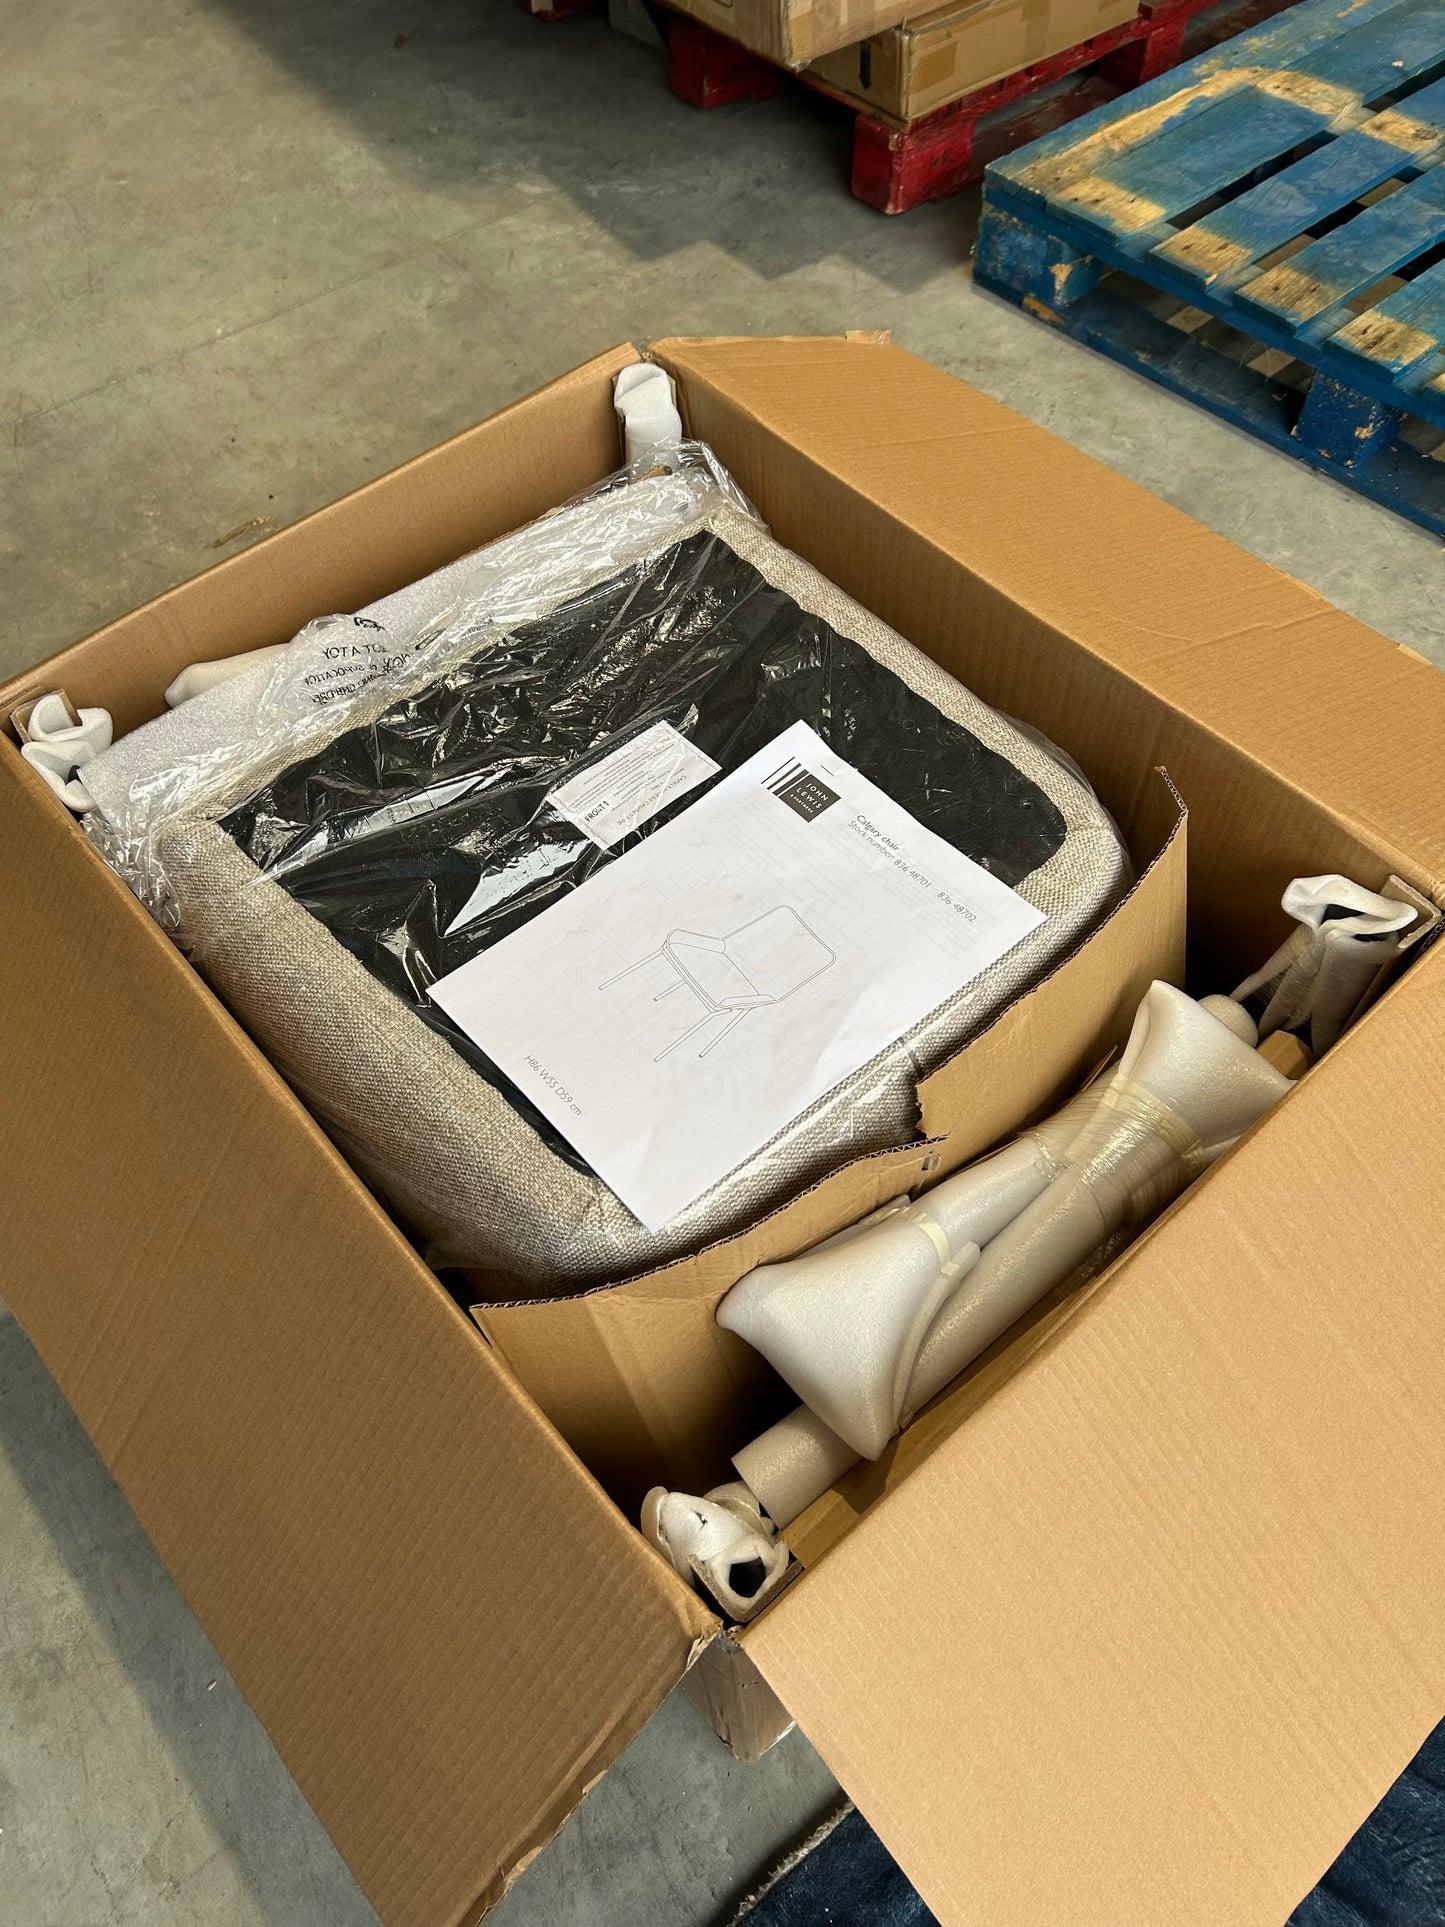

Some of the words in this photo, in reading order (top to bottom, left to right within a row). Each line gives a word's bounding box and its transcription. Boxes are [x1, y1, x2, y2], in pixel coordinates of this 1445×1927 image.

[796, 787, 822, 809] LEWIS
[805, 783, 829, 801] JOHN
[584, 803, 605, 822] FRONT
[856, 814, 882, 838] Calgary
[881, 836, 900, 851] chair
[848, 820, 868, 838] Stock
[893, 859, 909, 872] 836
[909, 870, 932, 888] 48701
[937, 891, 953, 905] 836
[953, 903, 977, 922] 48702
[524, 1054, 541, 1072] H86
[539, 1069, 559, 1089] W55
[554, 1086, 573, 1103] D59
[569, 1103, 582, 1116] cm
